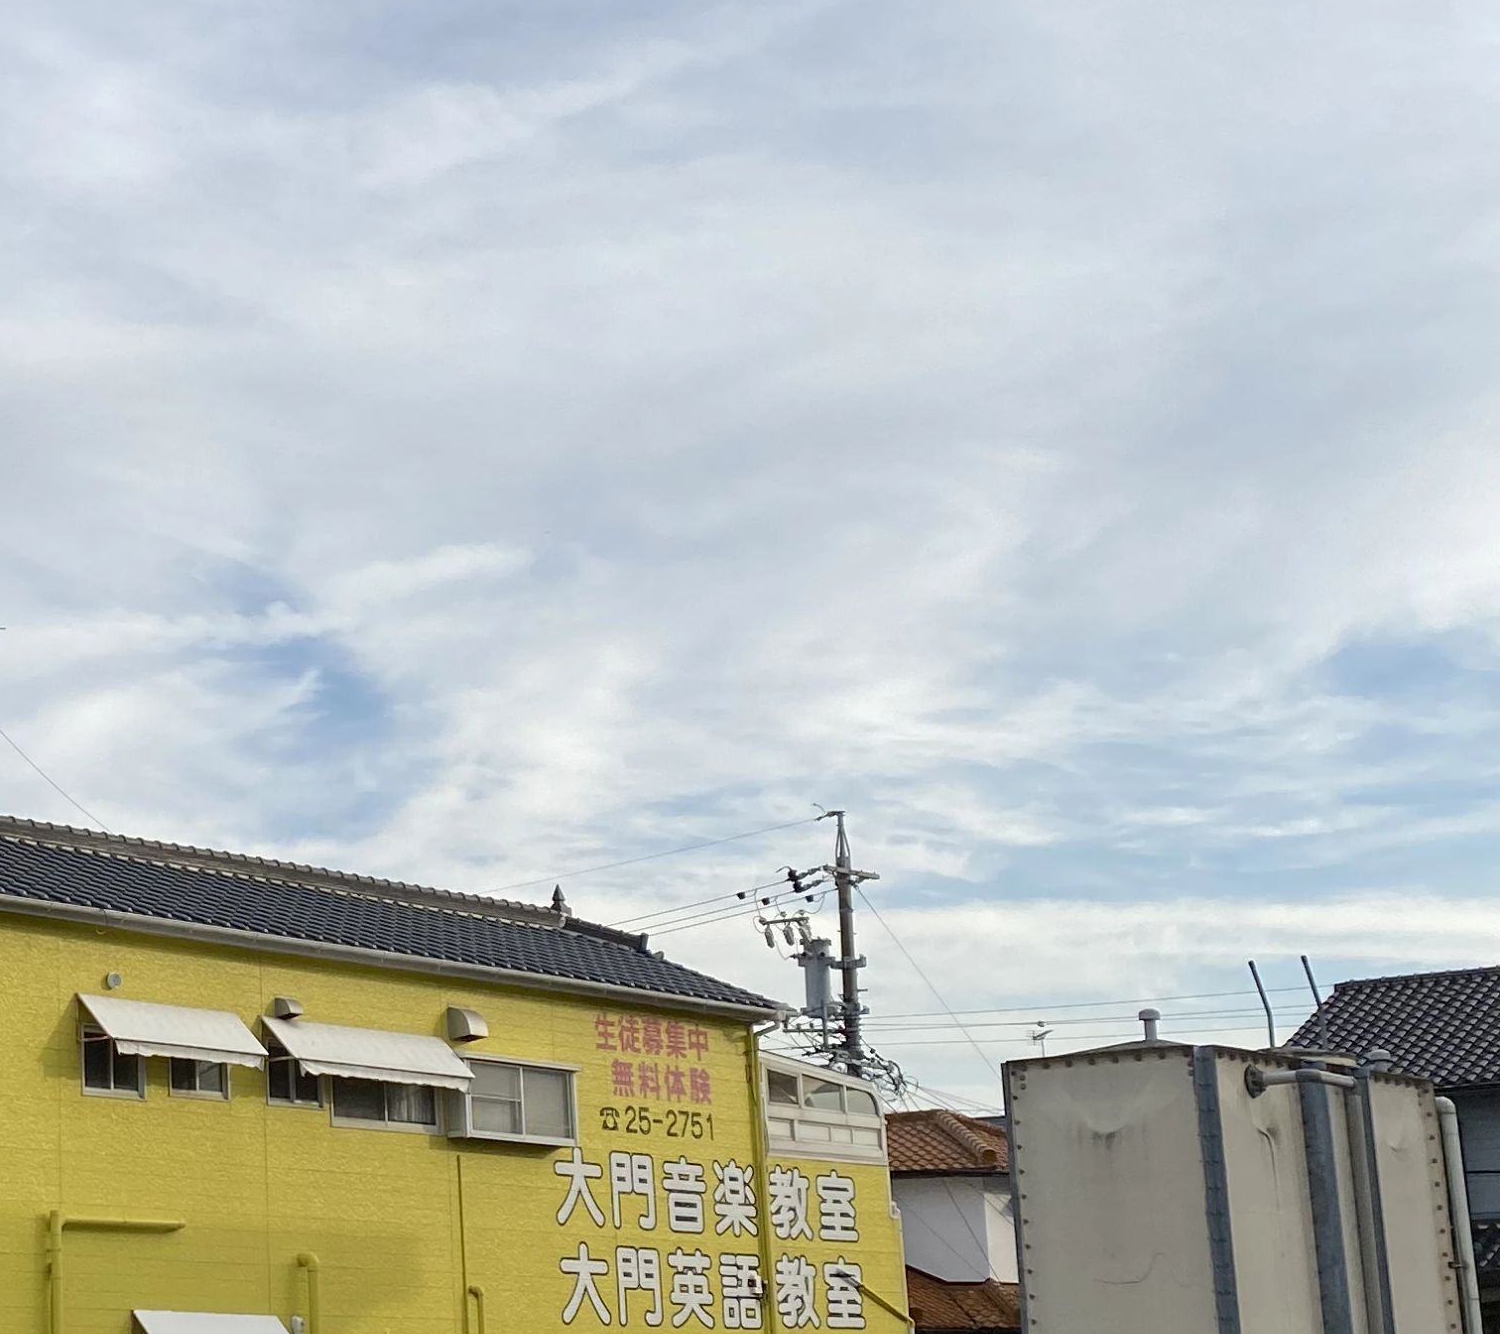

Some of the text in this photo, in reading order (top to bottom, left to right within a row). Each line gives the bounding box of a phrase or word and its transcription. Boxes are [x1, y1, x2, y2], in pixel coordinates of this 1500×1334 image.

[595, 1012, 709, 1061] 生徒募集中
[611, 1058, 712, 1105] 無料体験
[625, 1105, 714, 1141] 25-2751
[553, 1146, 860, 1243] 大門音楽教室
[559, 1241, 867, 1330] 大門英語教室
